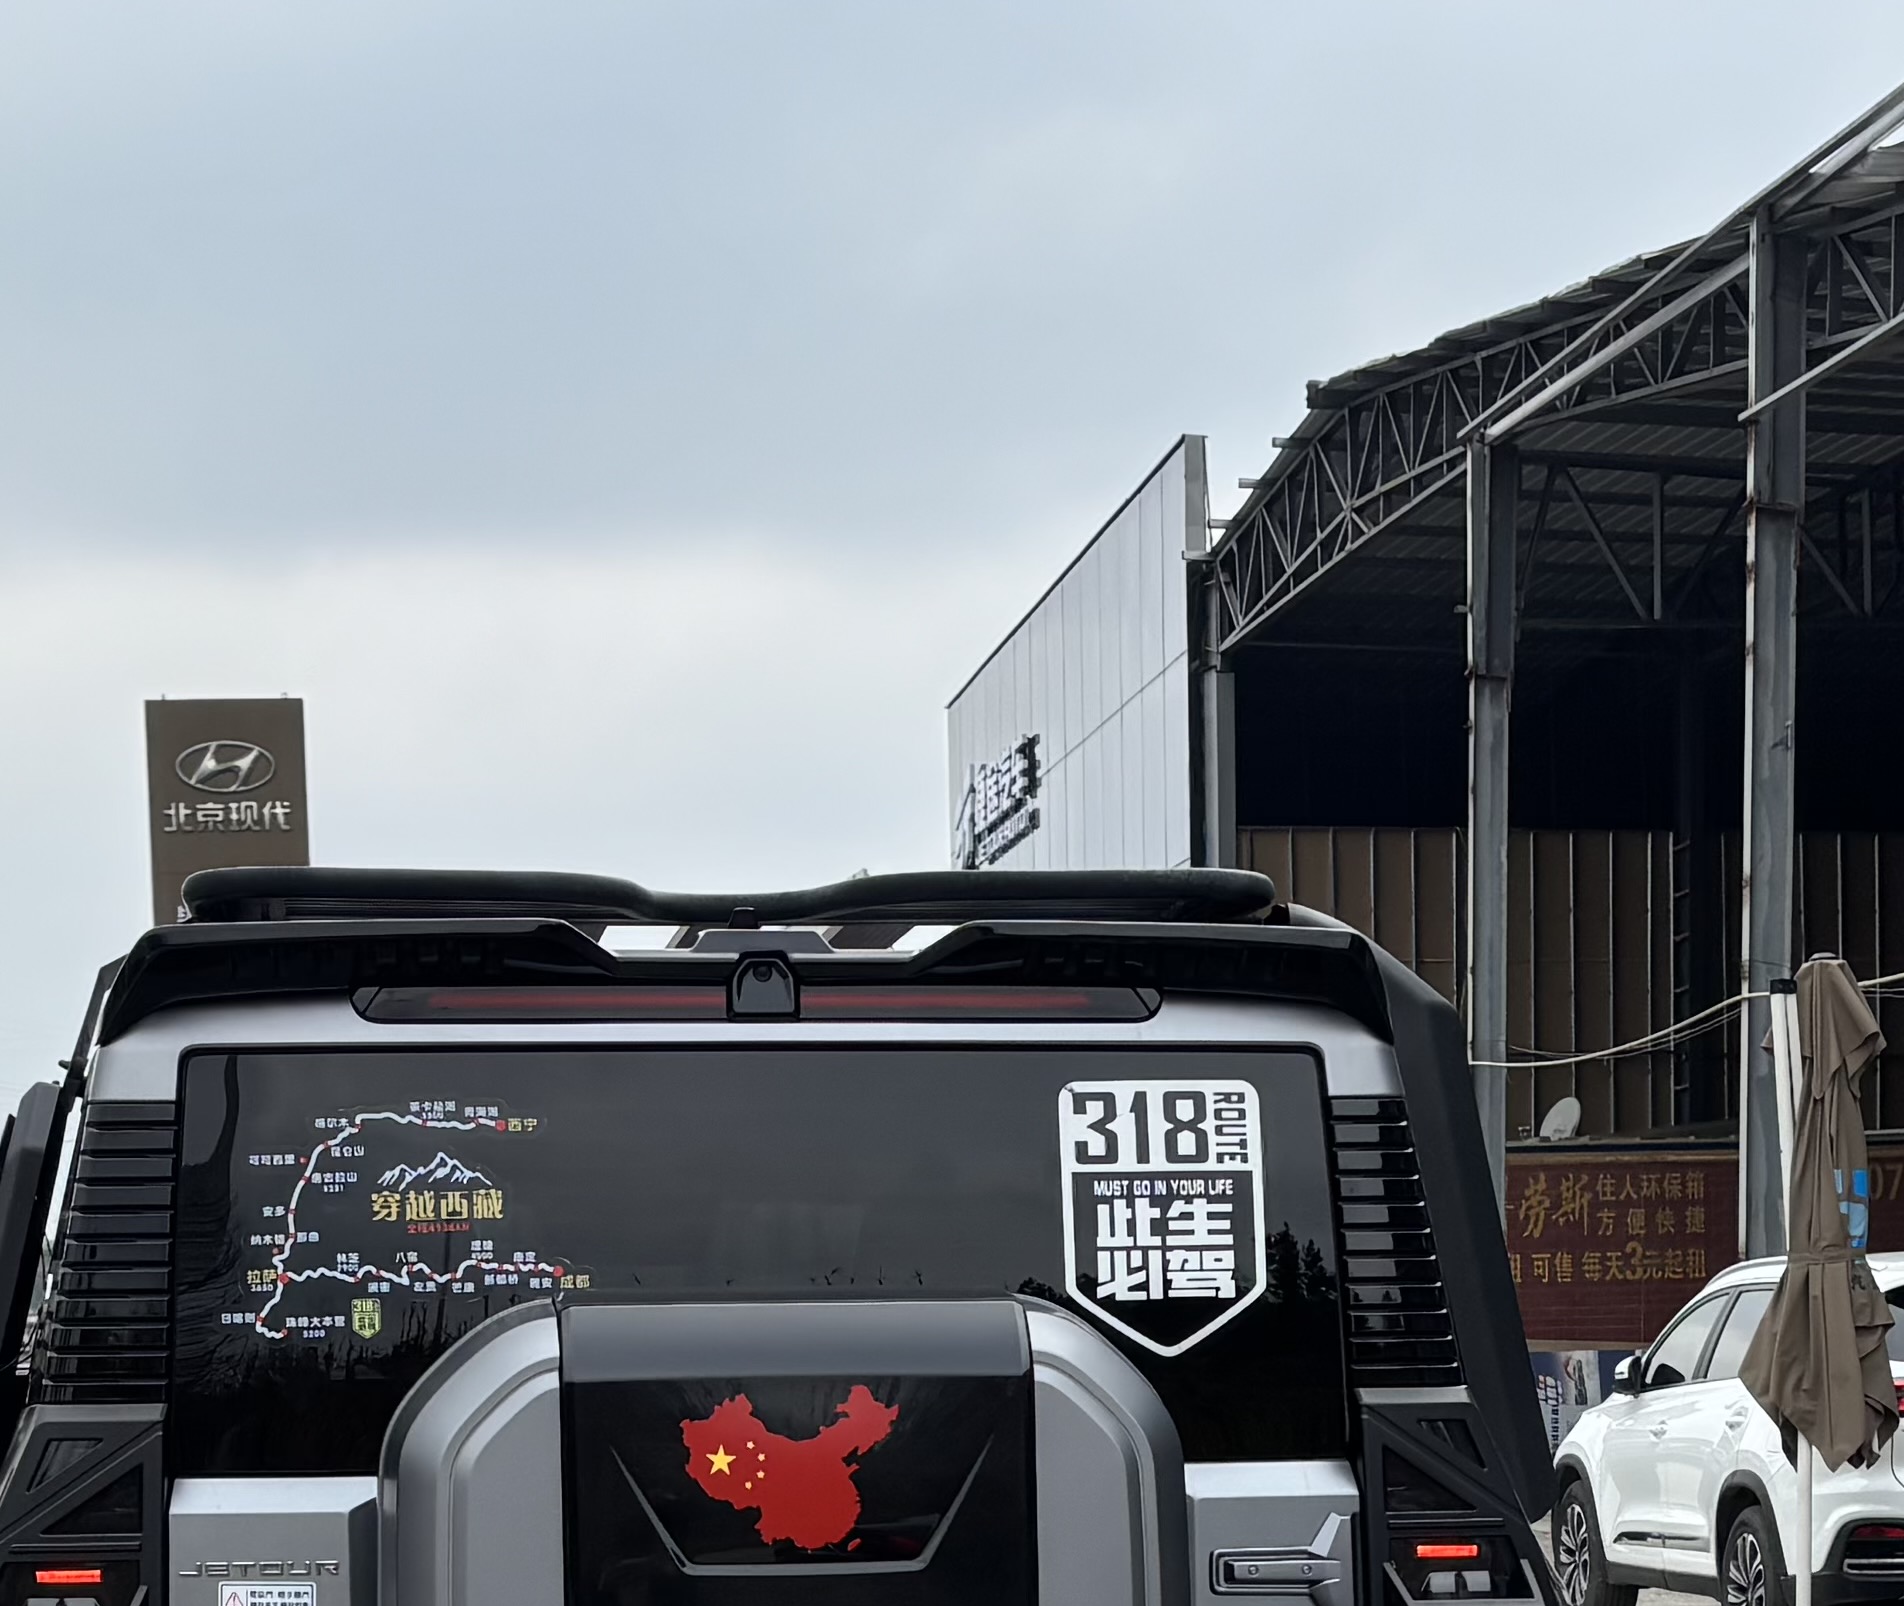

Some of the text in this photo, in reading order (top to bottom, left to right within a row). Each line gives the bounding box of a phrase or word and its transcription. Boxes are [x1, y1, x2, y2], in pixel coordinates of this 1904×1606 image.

[162, 800, 292, 832] 北京现代
[507, 1118, 538, 1132] 西宁
[1072, 1090, 1210, 1165] 318
[1212, 1091, 1249, 1165] ROUTE
[1093, 1178, 1234, 1196] MUST GO IN YOUR LIFE
[1596, 1170, 1706, 1201] 住人环保箱
[370, 1188, 504, 1222] 穿越西藏
[1096, 1197, 1234, 1248] 此生
[1597, 1206, 1706, 1236] 方便快捷
[247, 1269, 277, 1284] 拉萨
[1096, 1249, 1237, 1301] 必驾
[1531, 1251, 1574, 1283] 可售
[1582, 1240, 1707, 1281] 每天3元起租
[560, 1274, 590, 1289] 成都
[178, 1559, 340, 1578] JETOUR
